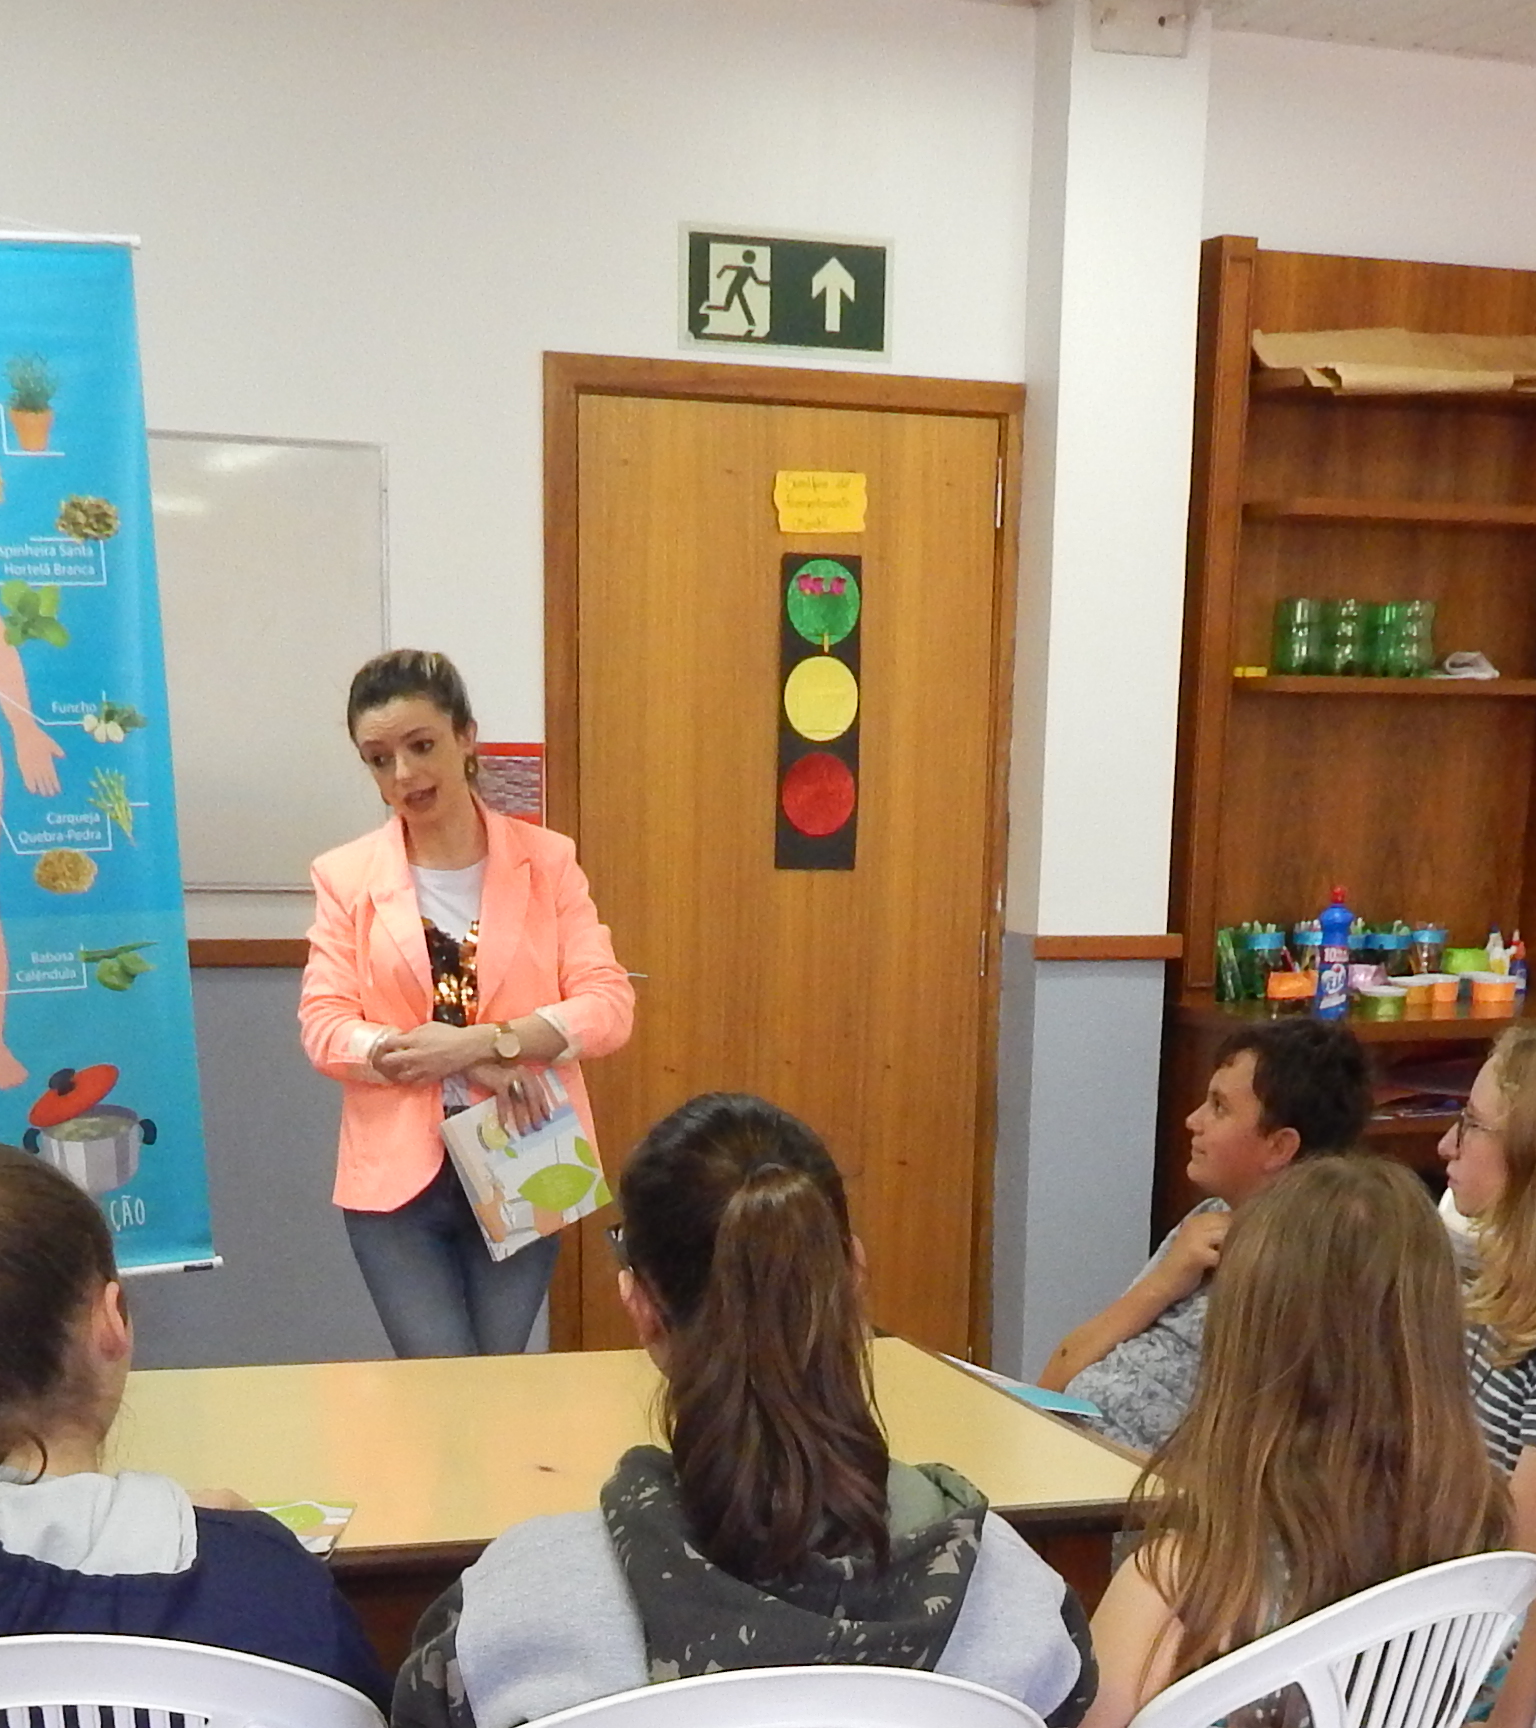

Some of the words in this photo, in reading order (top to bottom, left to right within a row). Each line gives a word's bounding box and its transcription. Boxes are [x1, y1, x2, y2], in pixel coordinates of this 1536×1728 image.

[59, 544, 94, 557] Santa
[4, 563, 51, 576] Hortelã
[54, 563, 95, 577] Branca
[51, 700, 97, 714] Funcho
[46, 811, 101, 826] Carqueja
[30, 951, 75, 965] Babosa
